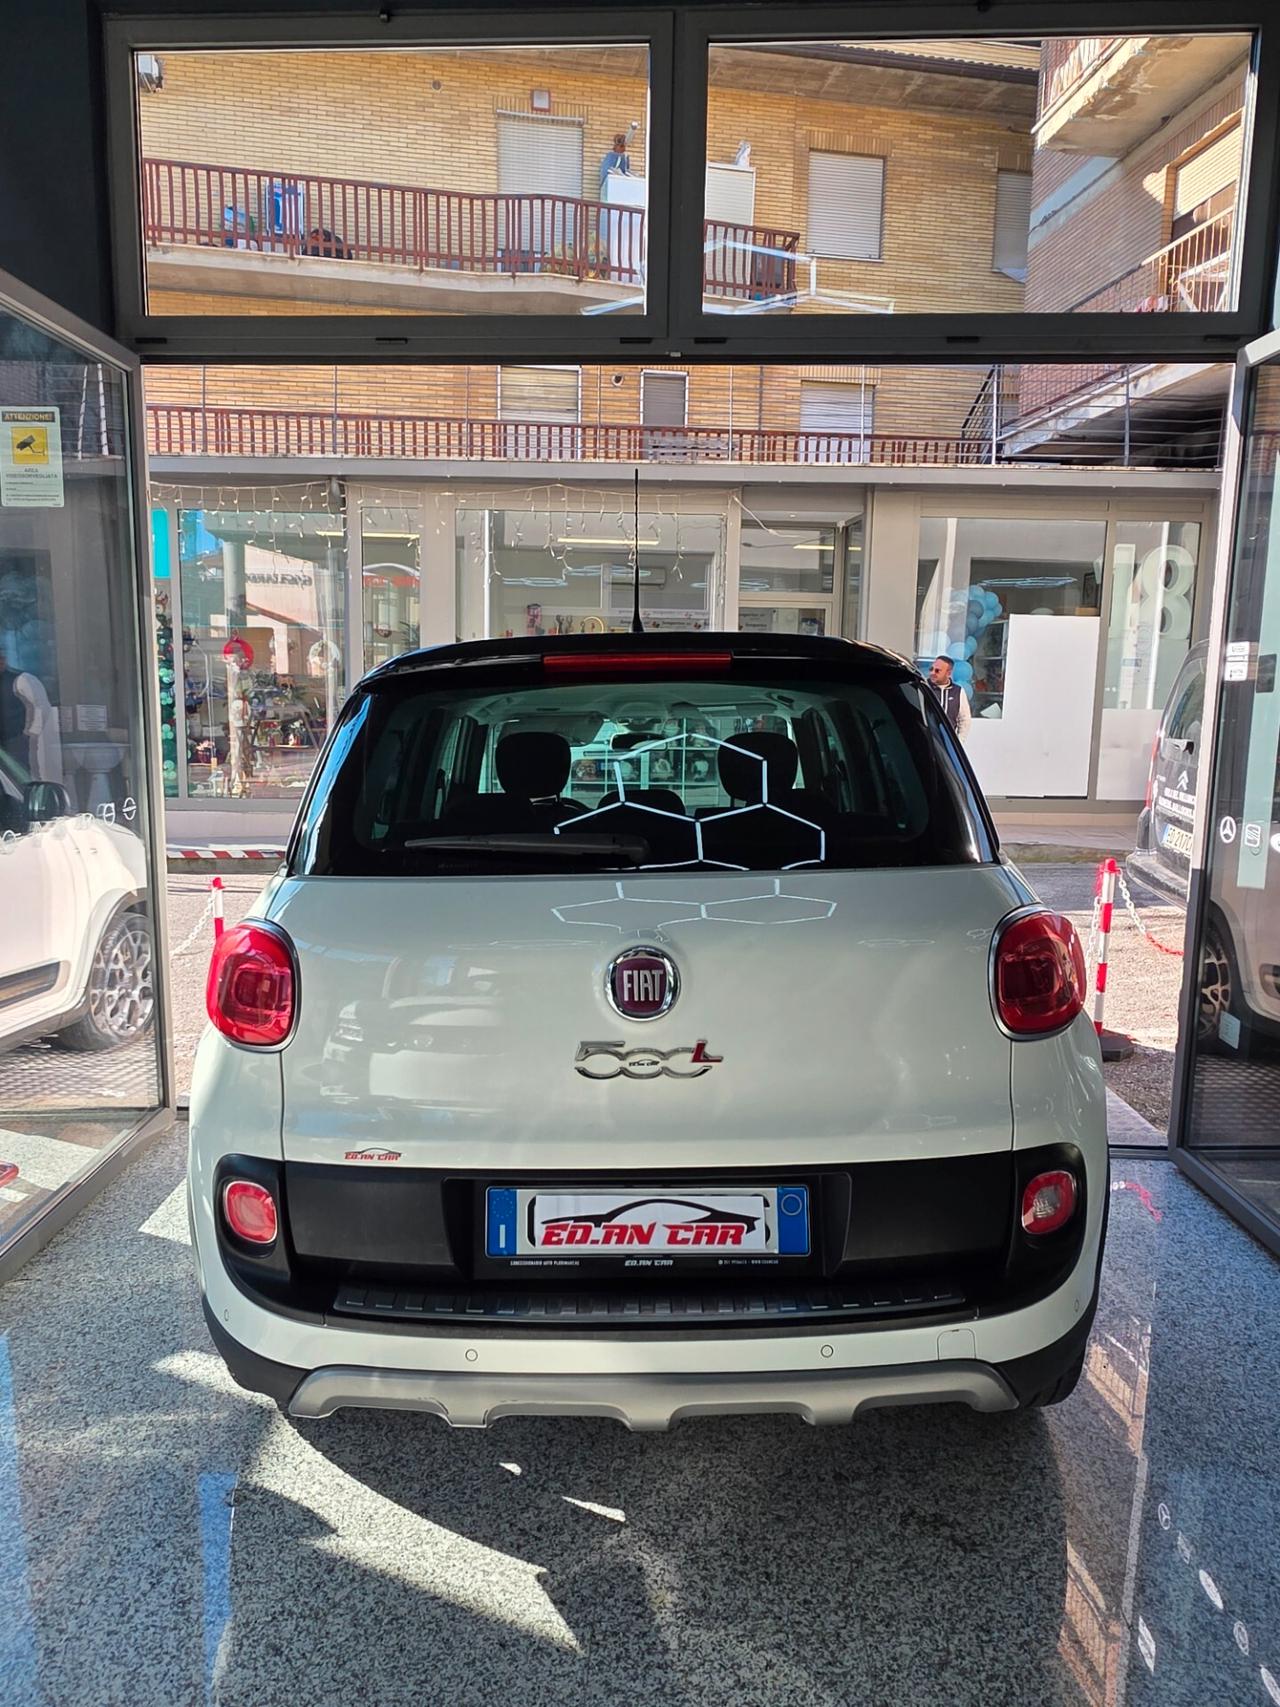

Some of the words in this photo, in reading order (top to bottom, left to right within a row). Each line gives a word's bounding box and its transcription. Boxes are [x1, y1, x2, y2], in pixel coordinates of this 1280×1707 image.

[622, 970, 664, 1001] FIAT
[575, 1039, 724, 1080] 500L
[344, 1152, 375, 1160] ED.AN
[376, 1153, 399, 1161] CAR
[541, 1221, 657, 1246] ED.AN
[662, 1223, 745, 1246] CAR
[624, 1259, 653, 1267] ED.AN
[654, 1259, 673, 1267] CAR
